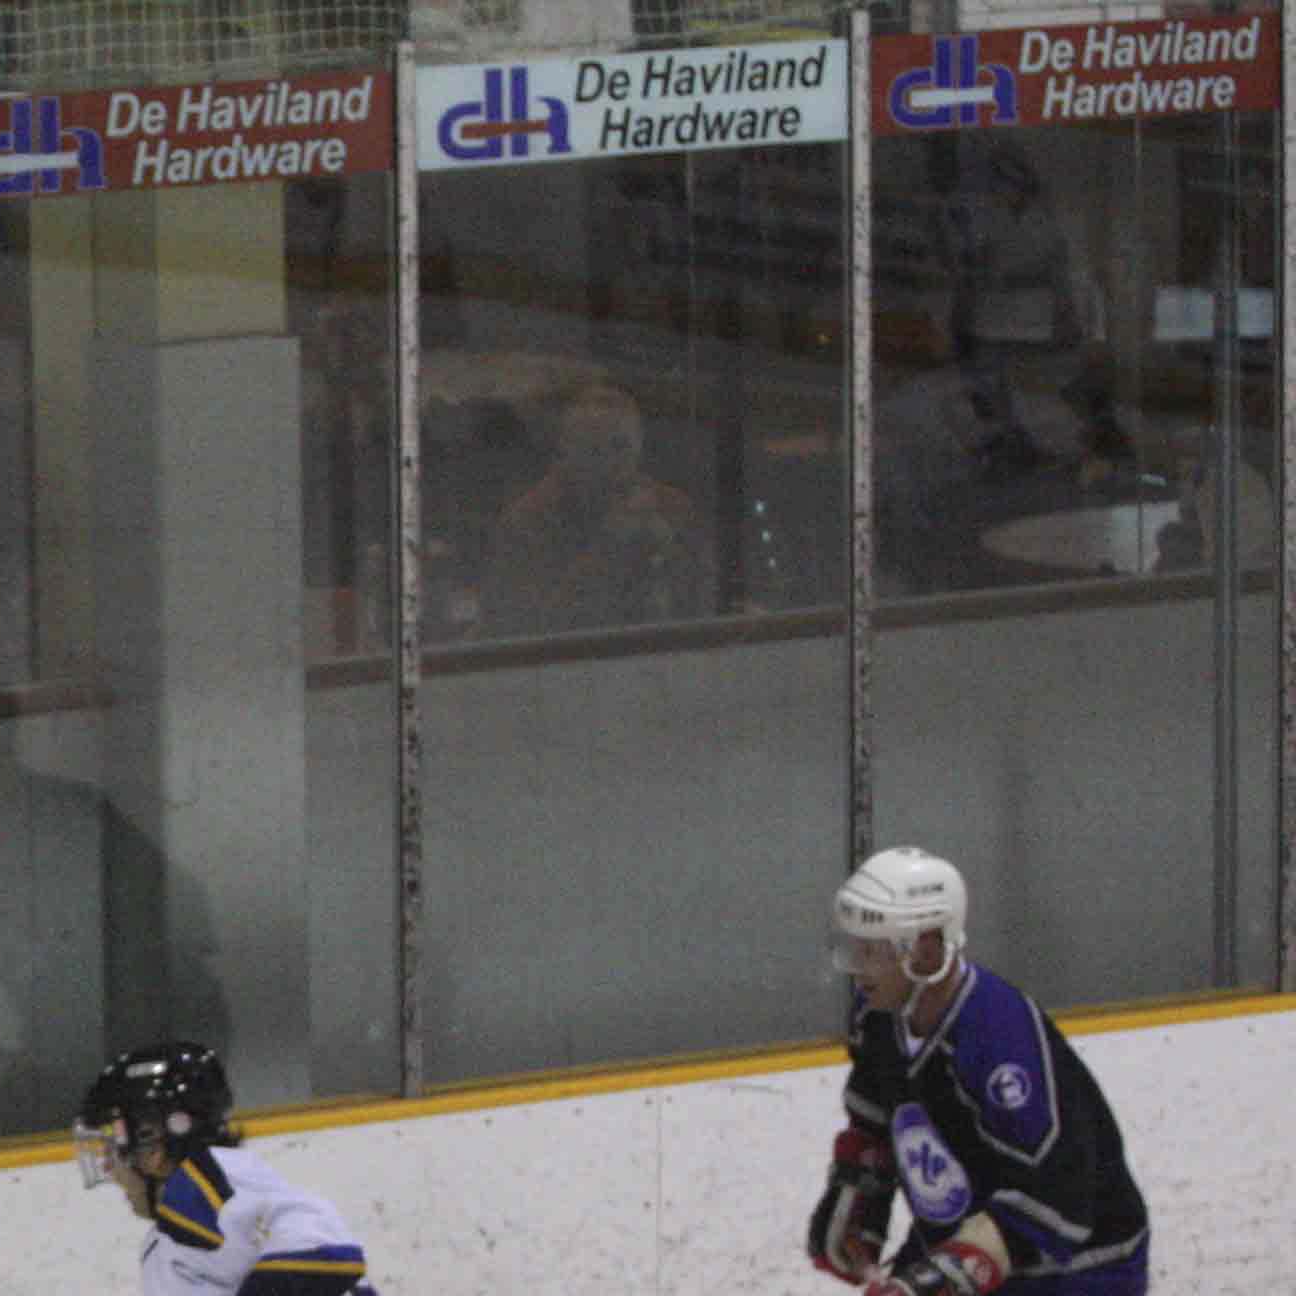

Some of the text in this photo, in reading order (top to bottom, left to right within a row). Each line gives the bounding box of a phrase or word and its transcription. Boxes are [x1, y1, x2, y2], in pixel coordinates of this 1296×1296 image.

[1018, 17, 1261, 74] De Haviland
[574, 45, 828, 103] De Haviland
[1042, 72, 1236, 120] Hardware
[106, 76, 374, 137] De Haviland
[599, 102, 801, 150] Hardware
[132, 135, 347, 186] Hardware
